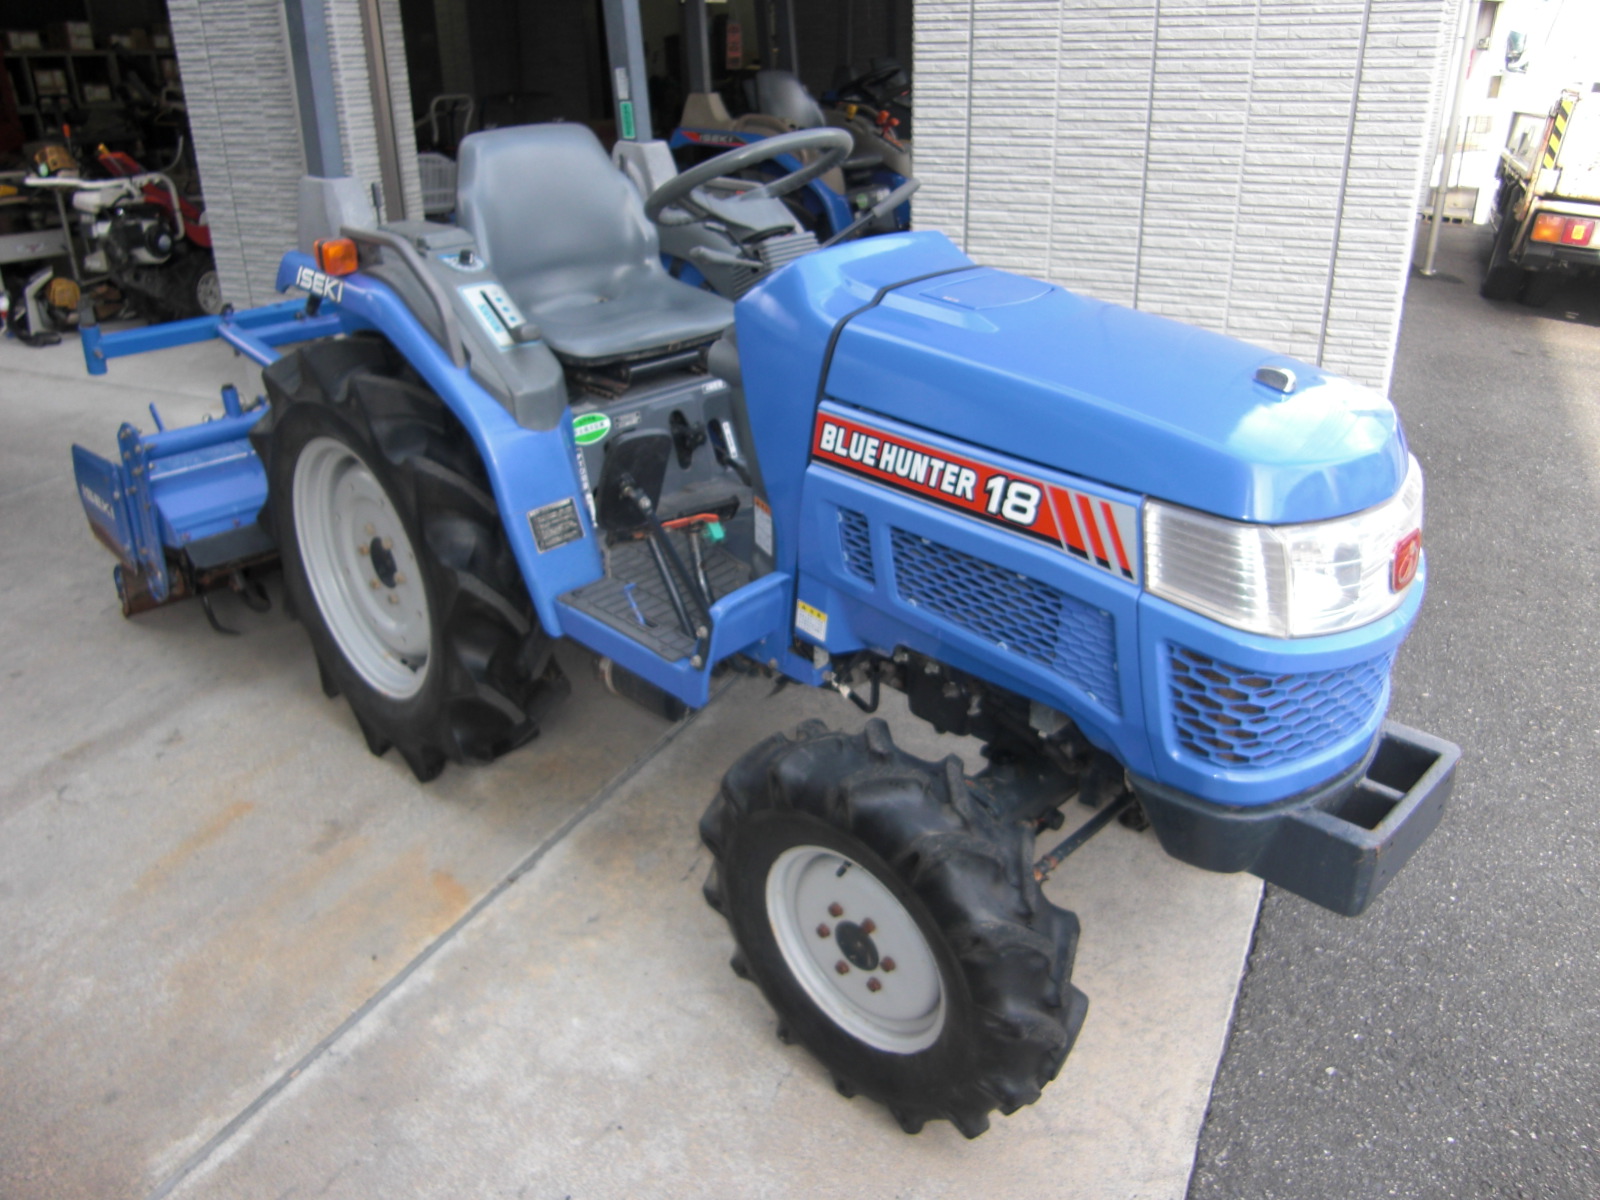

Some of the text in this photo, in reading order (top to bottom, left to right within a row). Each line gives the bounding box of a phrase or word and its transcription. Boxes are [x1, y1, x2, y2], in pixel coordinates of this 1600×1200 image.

[296, 265, 343, 304] ISEKI
[819, 421, 1042, 525] BLUE HUNTER 18
